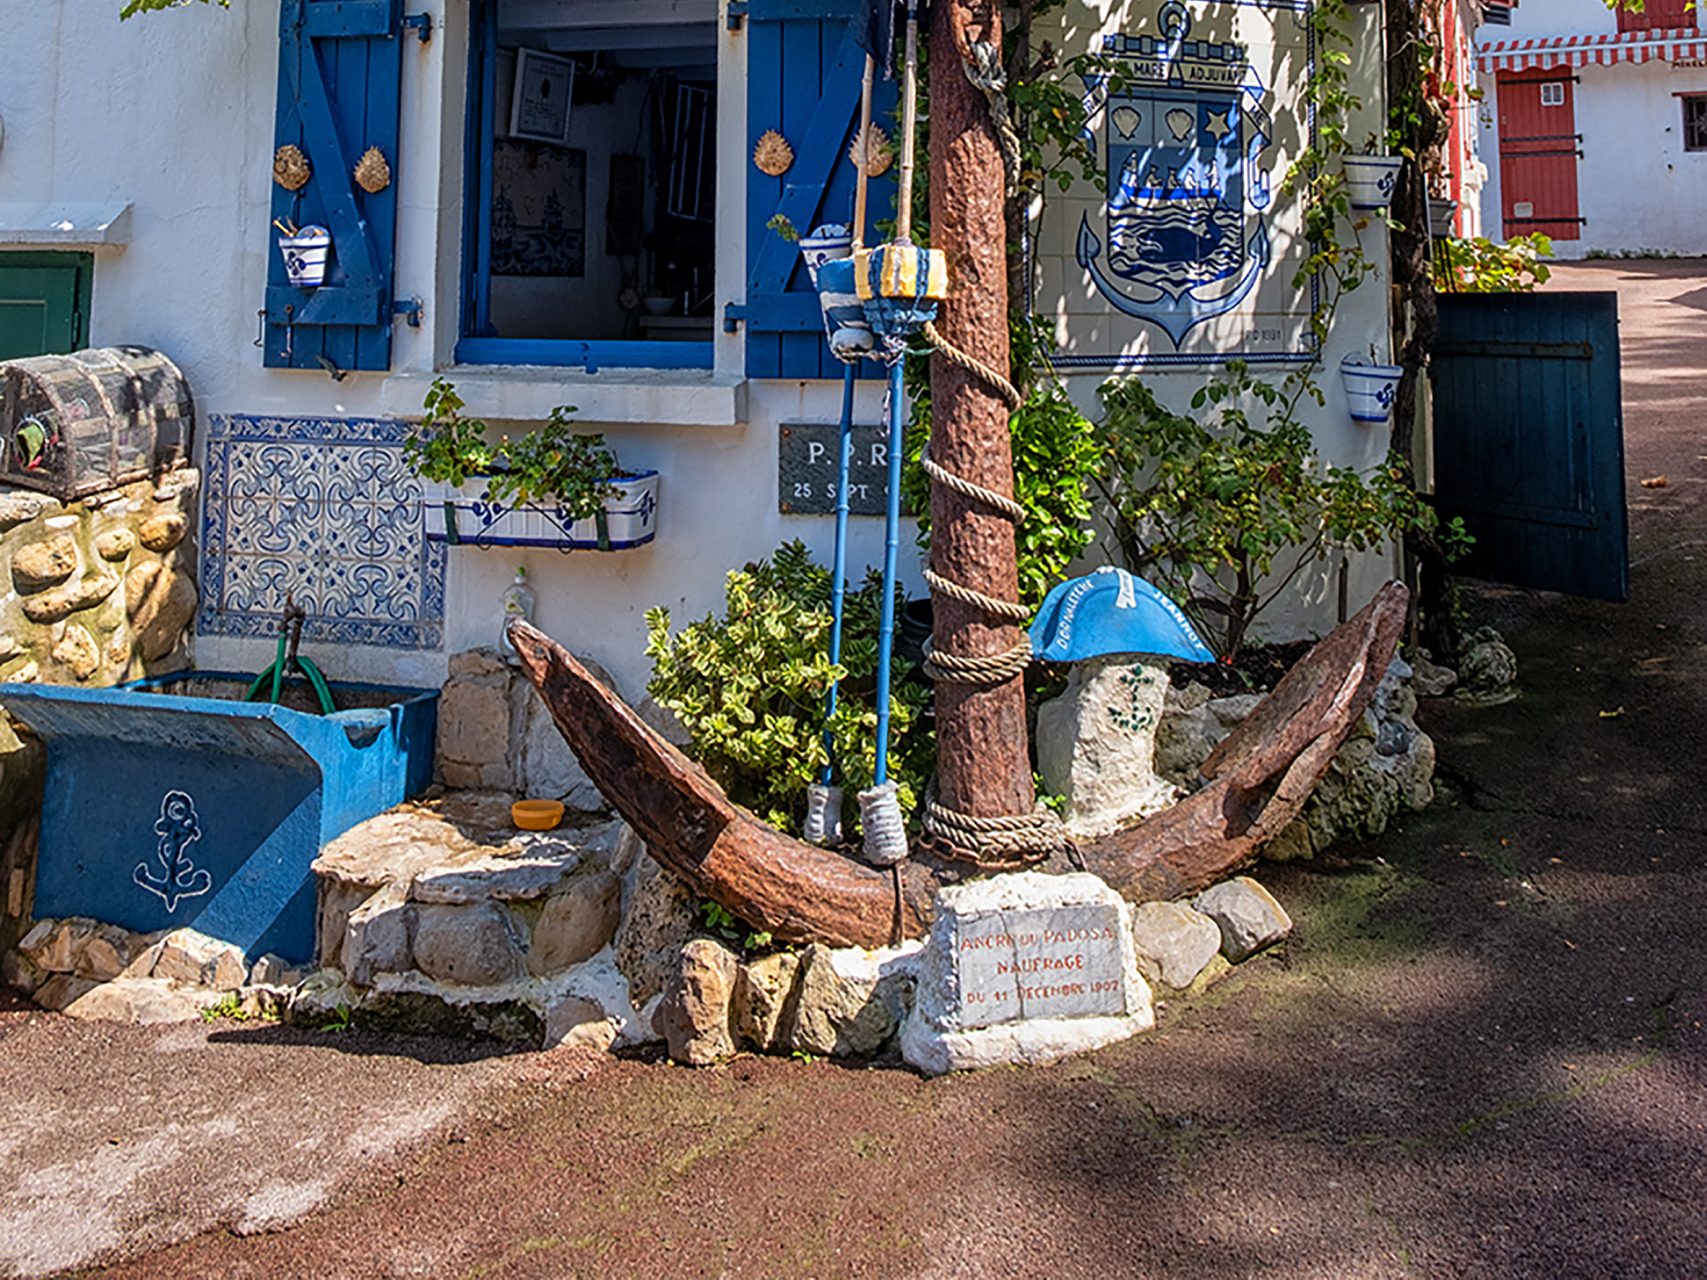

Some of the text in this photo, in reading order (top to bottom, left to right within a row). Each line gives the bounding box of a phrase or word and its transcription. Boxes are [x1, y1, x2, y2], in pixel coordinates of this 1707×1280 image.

[1133, 62, 1166, 77] MARE
[1249, 104, 1266, 126] ME
[793, 482, 812, 498] 25
[826, 483, 869, 500] SPT
[1152, 589, 1206, 651] JEANNOT
[1043, 927, 1115, 945] PADOSA
[966, 991, 985, 1004] DU
[993, 990, 1008, 1002] 11
